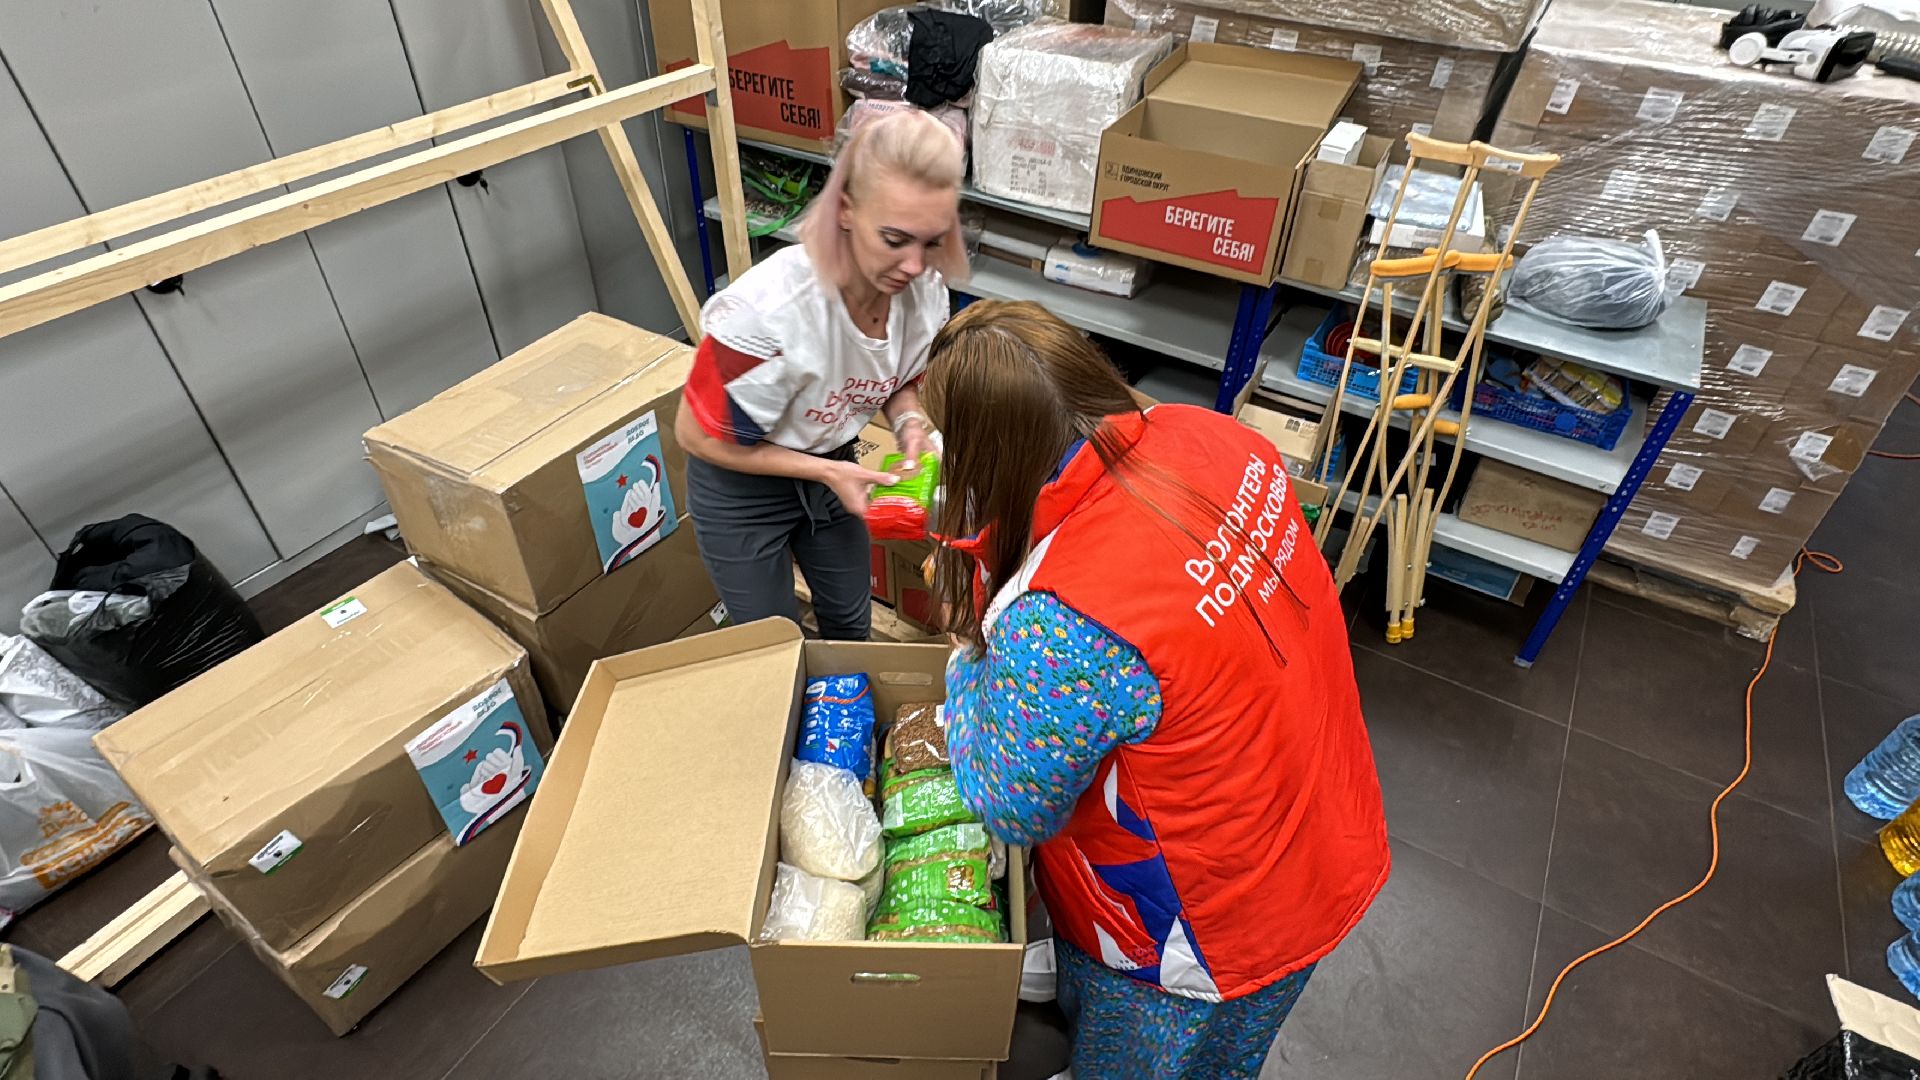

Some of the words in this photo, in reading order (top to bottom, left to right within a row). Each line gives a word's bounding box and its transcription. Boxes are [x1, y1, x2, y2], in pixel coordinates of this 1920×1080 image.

[728, 67, 795, 100] БЕРЕГИТЕ
[780, 102, 821, 129] СЕБЯ!
[1164, 205, 1236, 238] БЕРЕГИТЕ
[1212, 237, 1255, 263] СЕБЯ!
[1195, 464, 1288, 627] ПОДМОСКОВЬЯ
[1257, 569, 1280, 604] МЫ
[1273, 517, 1300, 577] РЯДОМ
